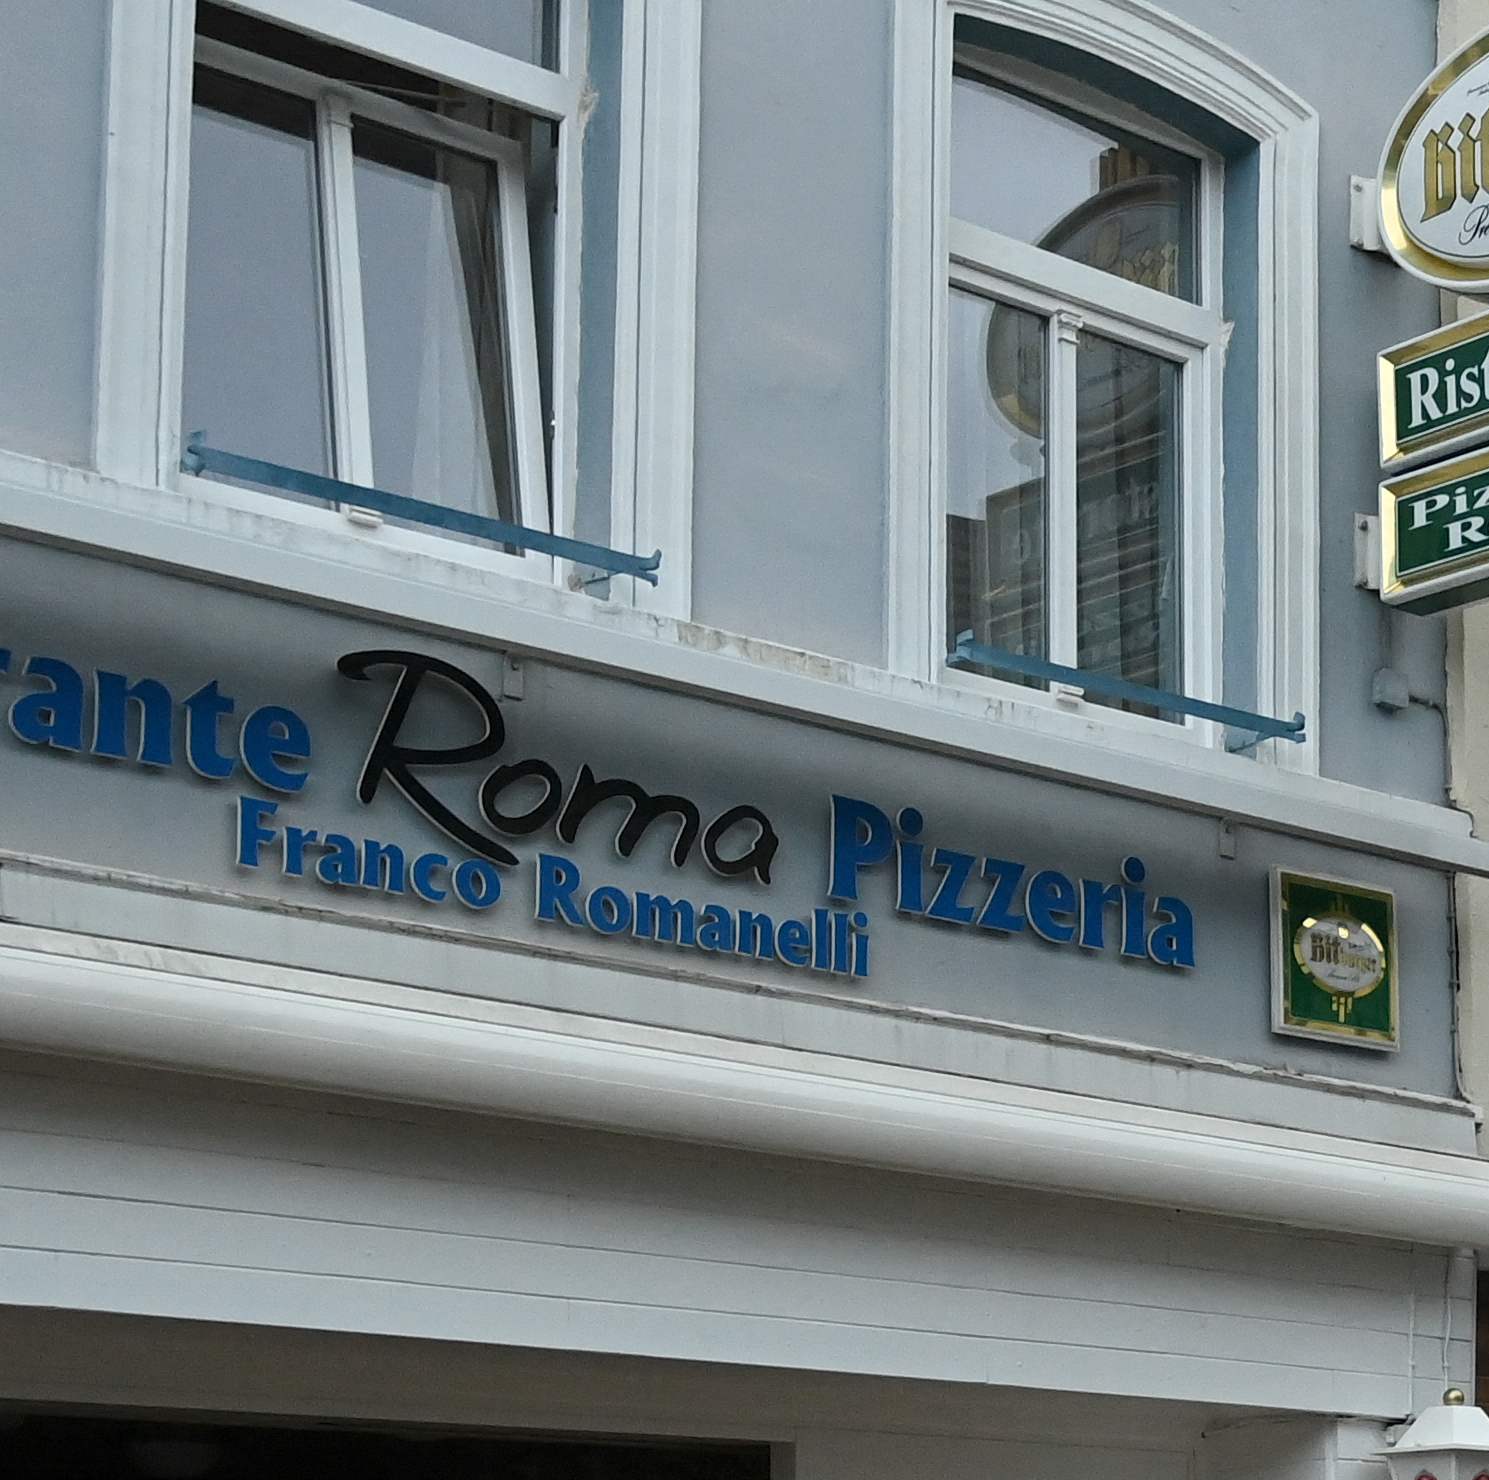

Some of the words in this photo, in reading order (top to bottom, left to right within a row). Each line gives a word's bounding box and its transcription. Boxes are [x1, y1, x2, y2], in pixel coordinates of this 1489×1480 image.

[0, 647, 311, 796] ante
[336, 649, 780, 887] Roma
[826, 794, 1196, 970] Pizzeria
[235, 796, 502, 911] Franco
[535, 852, 871, 978] Romanelli
